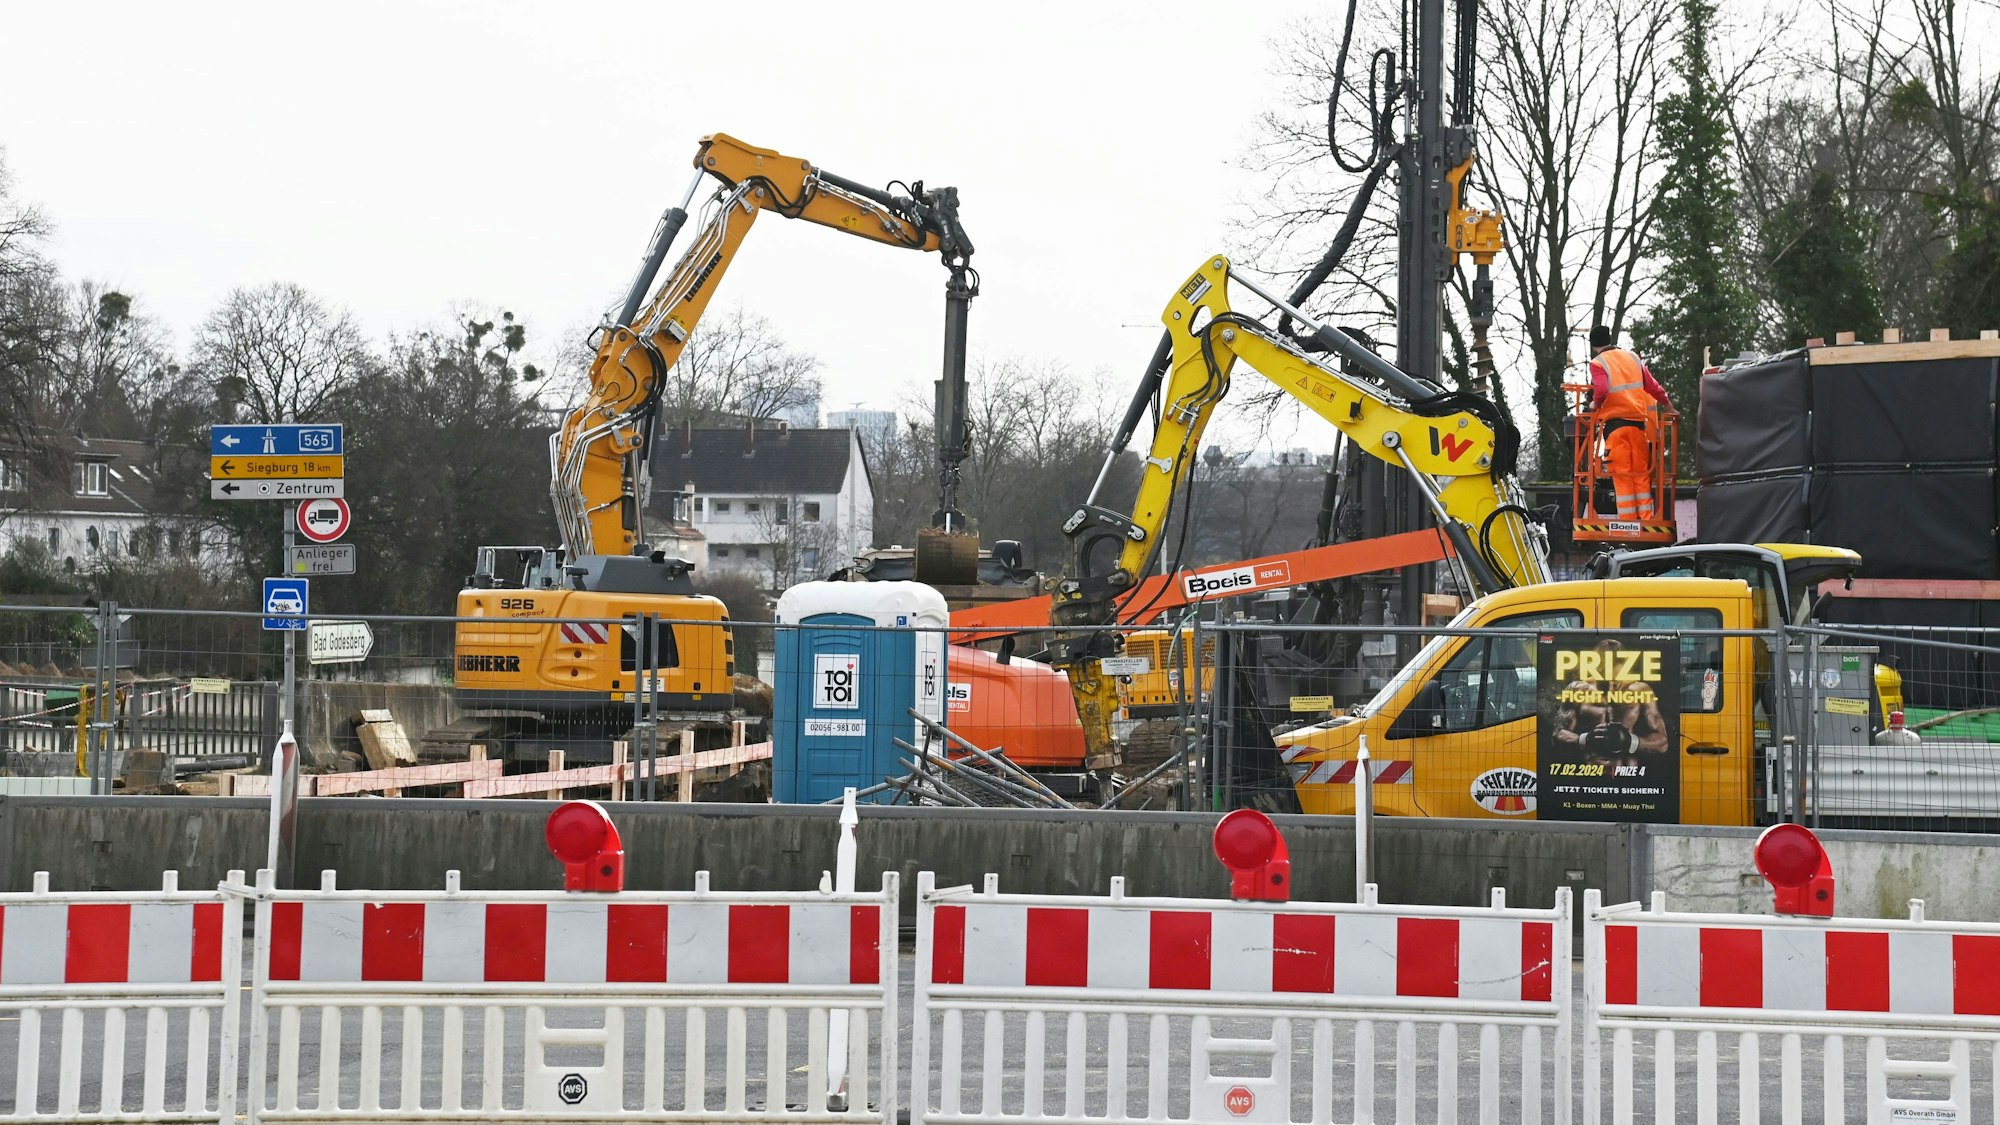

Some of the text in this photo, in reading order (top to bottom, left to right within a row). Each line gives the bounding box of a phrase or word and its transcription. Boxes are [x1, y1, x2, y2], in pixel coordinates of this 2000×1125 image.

[304, 434, 328, 446] 565
[247, 462, 331, 474] Siegburg 18 km
[276, 482, 335, 494] Zentrum
[1610, 523, 1639, 531] Boels
[296, 548, 348, 560] Anlieger
[312, 560, 334, 572] frei
[1260, 569, 1284, 579] RENTAL
[501, 598, 534, 609] 926
[512, 608, 545, 618] compact
[314, 629, 365, 653] Bad Godesberg
[1556, 650, 1661, 681] PRIZE
[825, 670, 852, 686] TOI
[824, 686, 852, 702] TOI
[810, 723, 831, 732] 02056
[836, 723, 850, 732] 981
[851, 723, 860, 732] 00
[1549, 763, 1646, 777] 17.02.2024 PRIZE 4
[1553, 785, 1580, 793] JETZT
[1582, 786, 1620, 794] TICKETS
[1621, 787, 1660, 795] SICHERN
[1623, 803, 1640, 811] Muay
[564, 1084, 582, 1094] AVS
[1230, 1097, 1250, 1106] AVS
